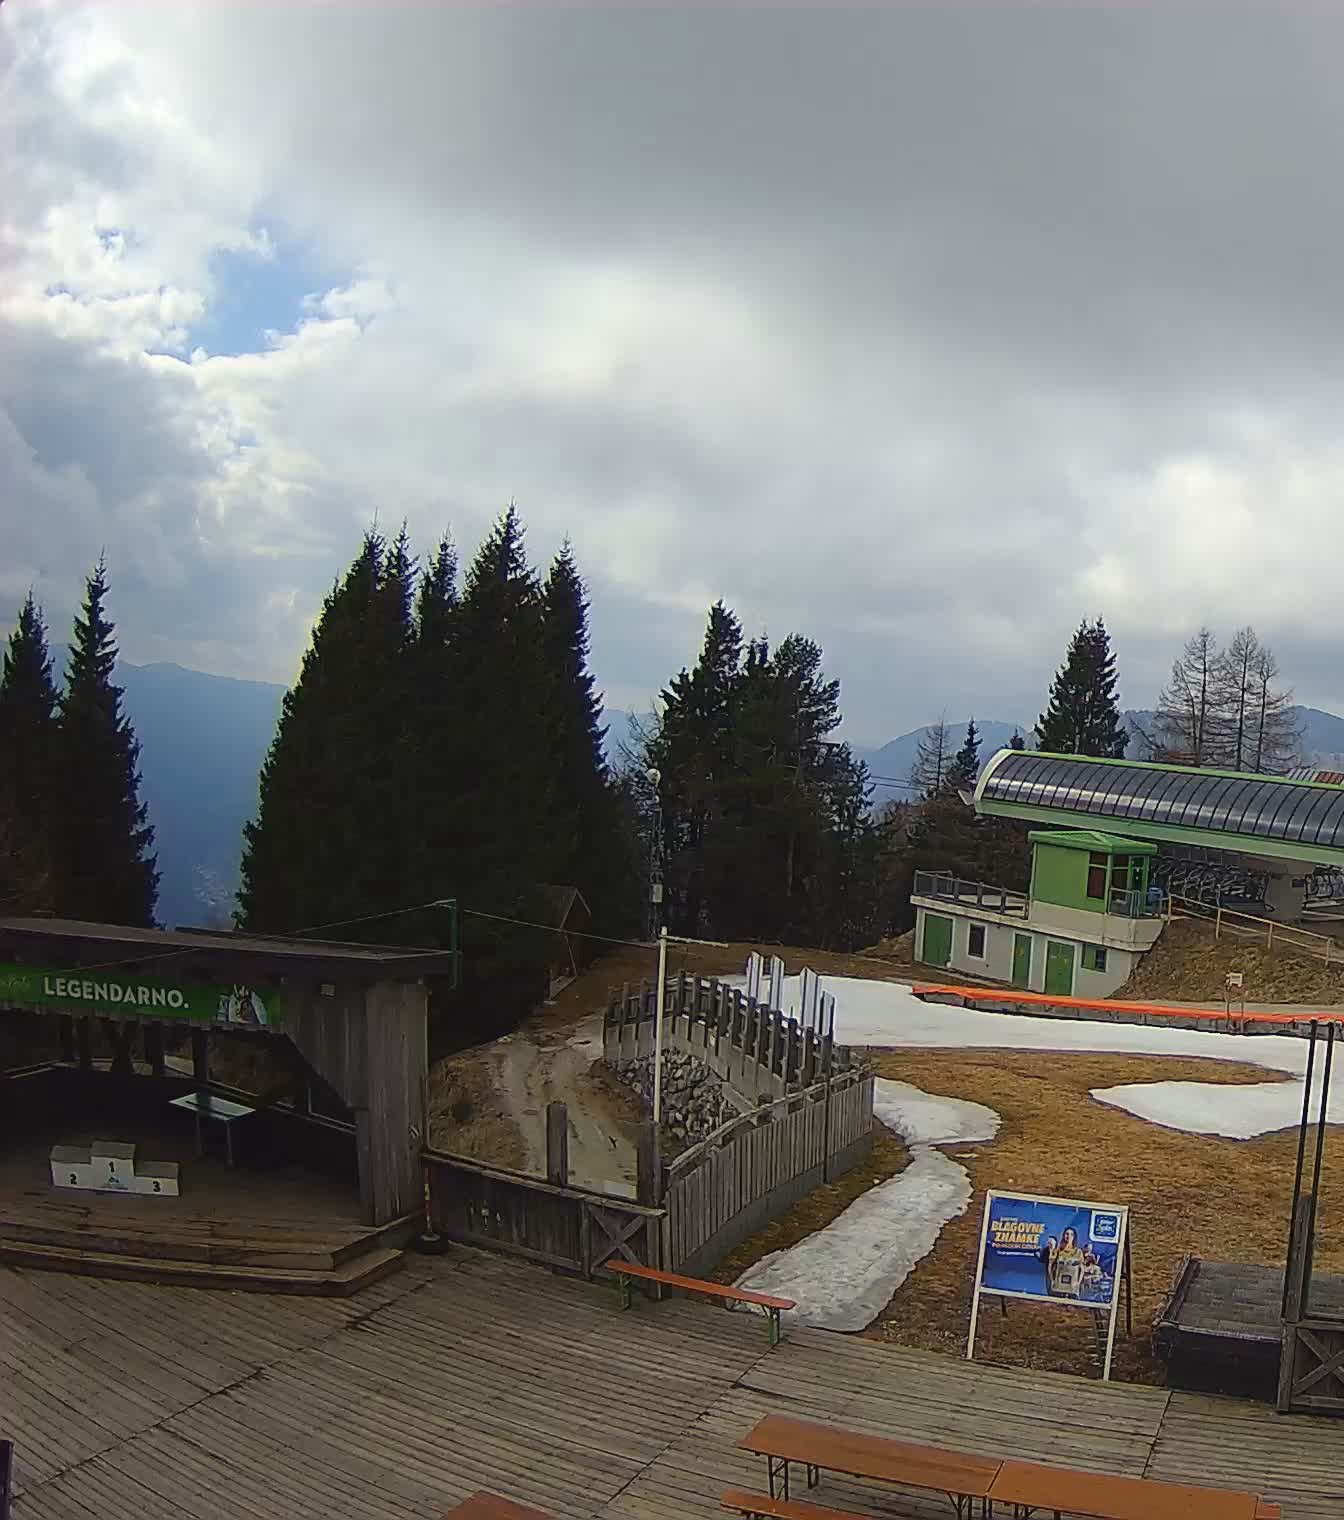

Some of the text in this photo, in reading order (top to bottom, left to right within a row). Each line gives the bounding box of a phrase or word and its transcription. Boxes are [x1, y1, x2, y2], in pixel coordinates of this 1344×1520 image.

[43, 976, 190, 1009] LEGENDARNO.
[108, 1161, 115, 1173] 1
[69, 1173, 77, 1185] 2
[152, 1180, 161, 1192] 3
